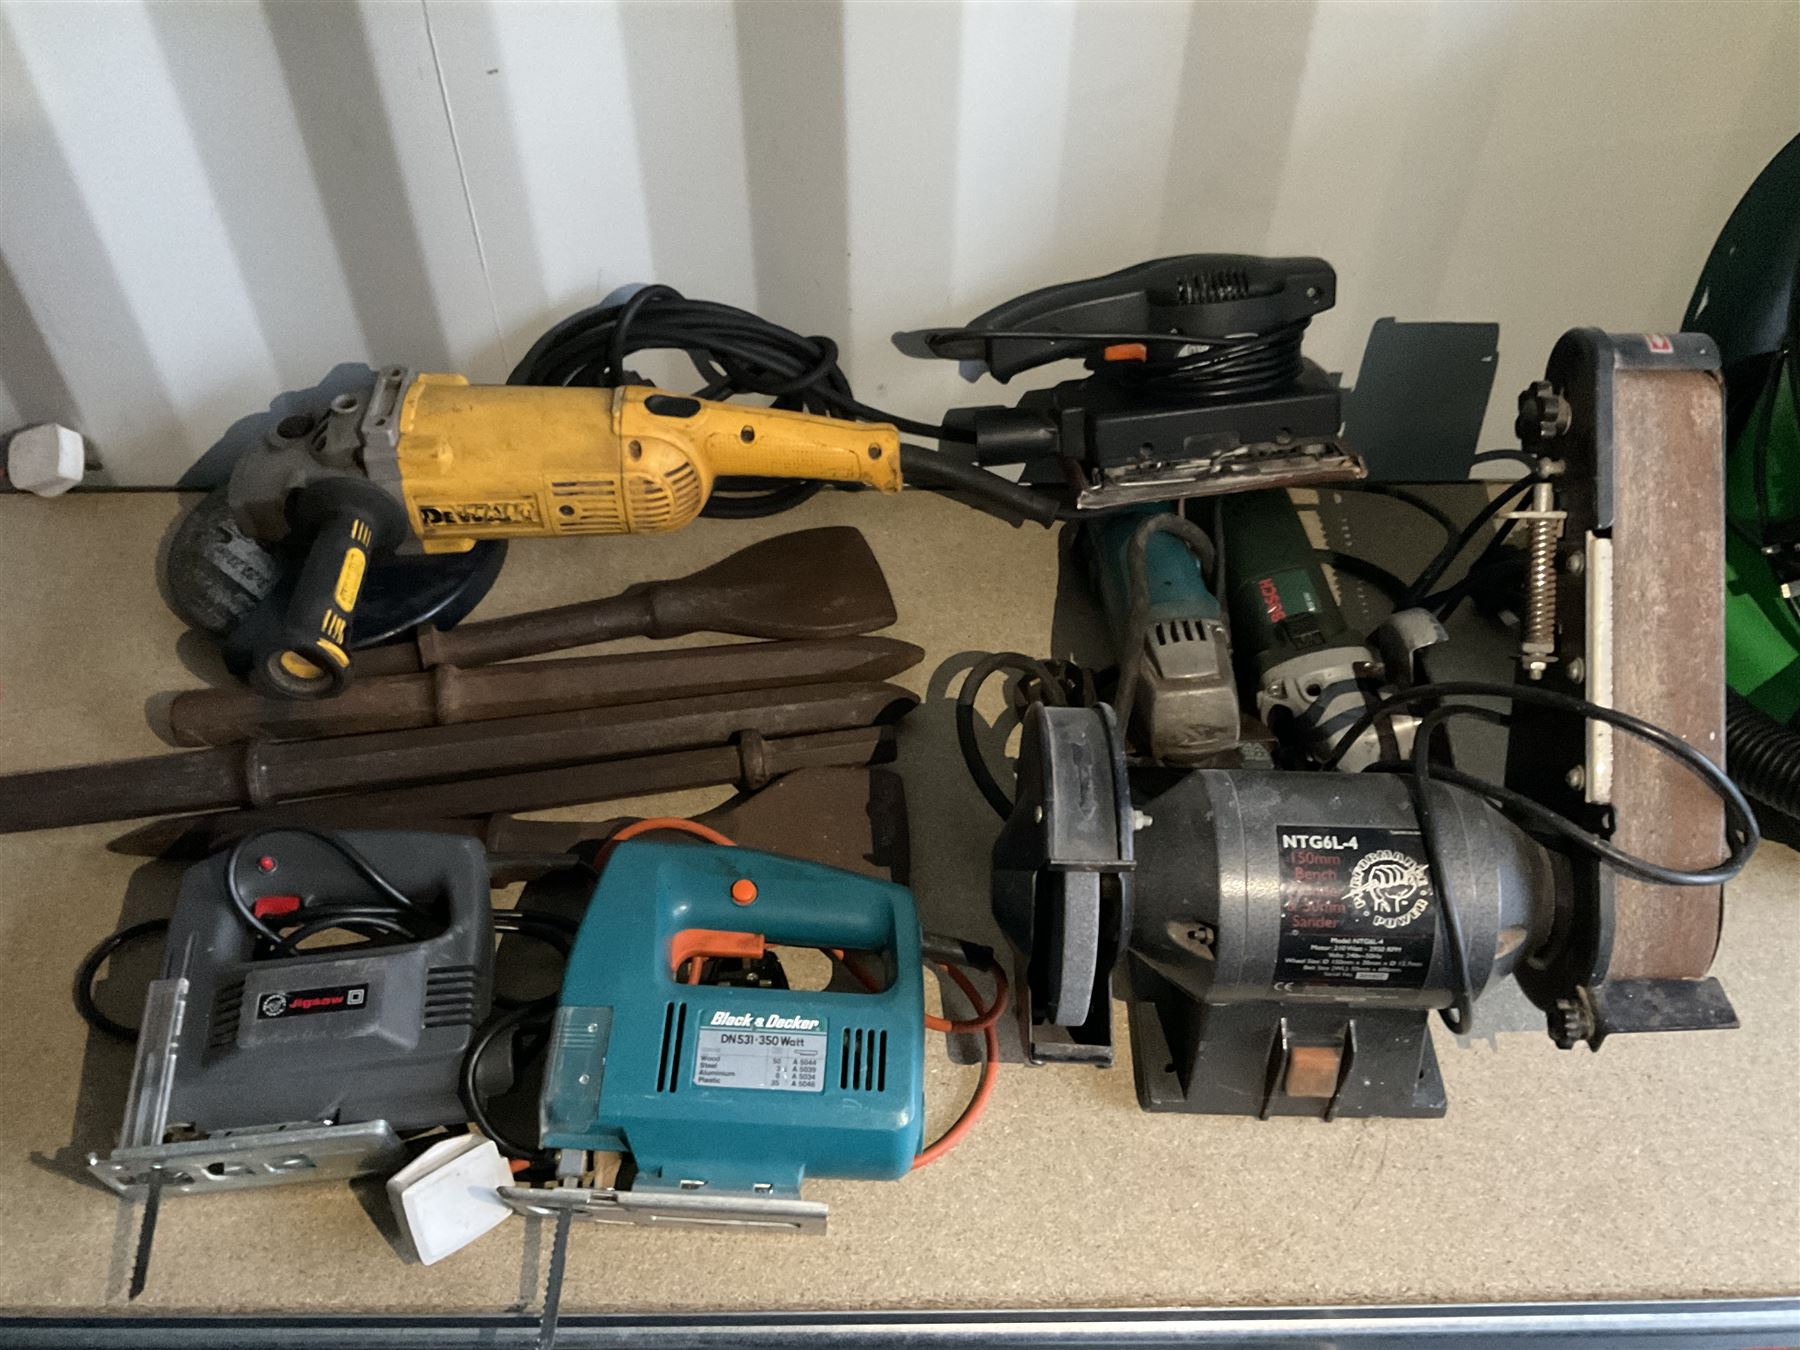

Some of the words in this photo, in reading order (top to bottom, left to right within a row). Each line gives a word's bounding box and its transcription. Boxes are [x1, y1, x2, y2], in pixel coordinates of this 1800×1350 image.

[1258, 577, 1287, 624] BOSCH
[1282, 834, 1359, 850] NTG6L-4
[1290, 852, 1341, 865] 150mm
[1294, 867, 1337, 881] Bench
[1373, 899, 1429, 928] POWER
[1292, 915, 1341, 929] Sander
[289, 996, 344, 1009] Jigsaw
[711, 1011, 753, 1027] Black
[754, 1017, 764, 1027] &
[765, 1014, 820, 1030] Decker
[780, 1036, 804, 1047] Watt
[699, 1069, 735, 1077] Aluminium
